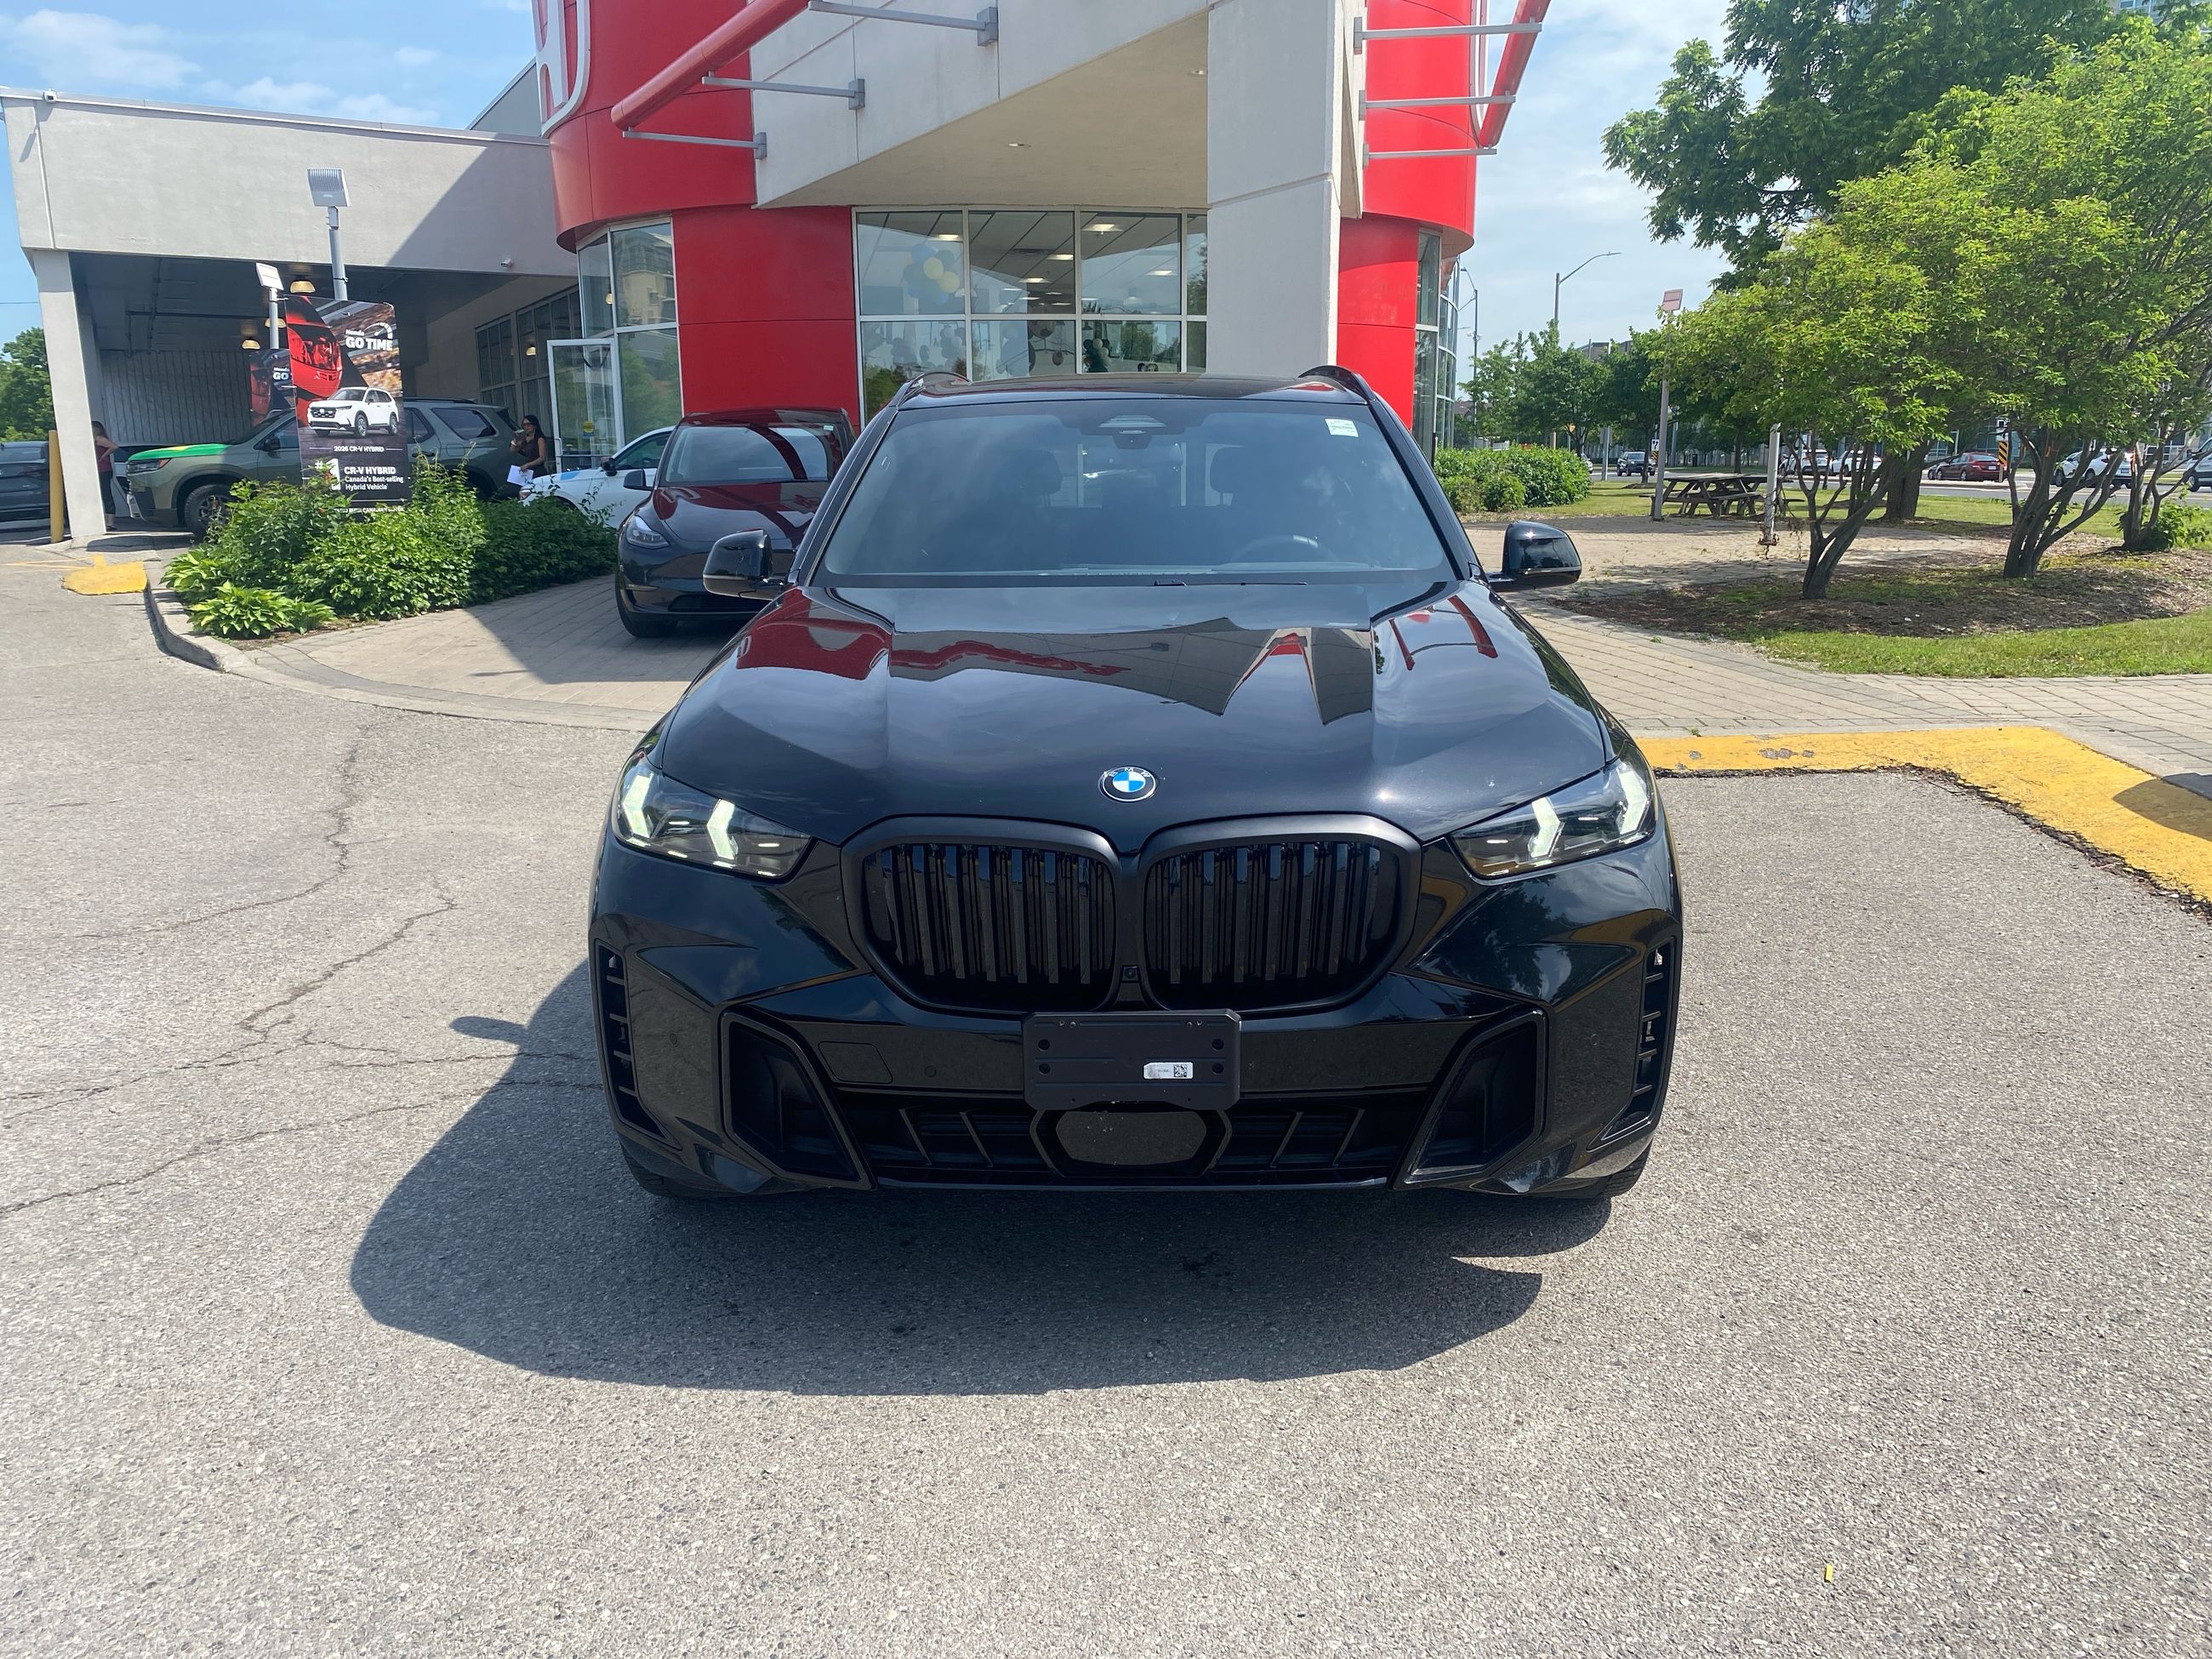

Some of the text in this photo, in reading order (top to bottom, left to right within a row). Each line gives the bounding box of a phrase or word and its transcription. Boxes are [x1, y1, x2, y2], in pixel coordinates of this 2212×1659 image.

[345, 336, 393, 351] GO TIME
[272, 372, 289, 380] GO
[344, 466, 396, 475] CR-V HYBRID
[345, 483, 366, 492] Hybrid
[1108, 767, 1151, 778] BMW
